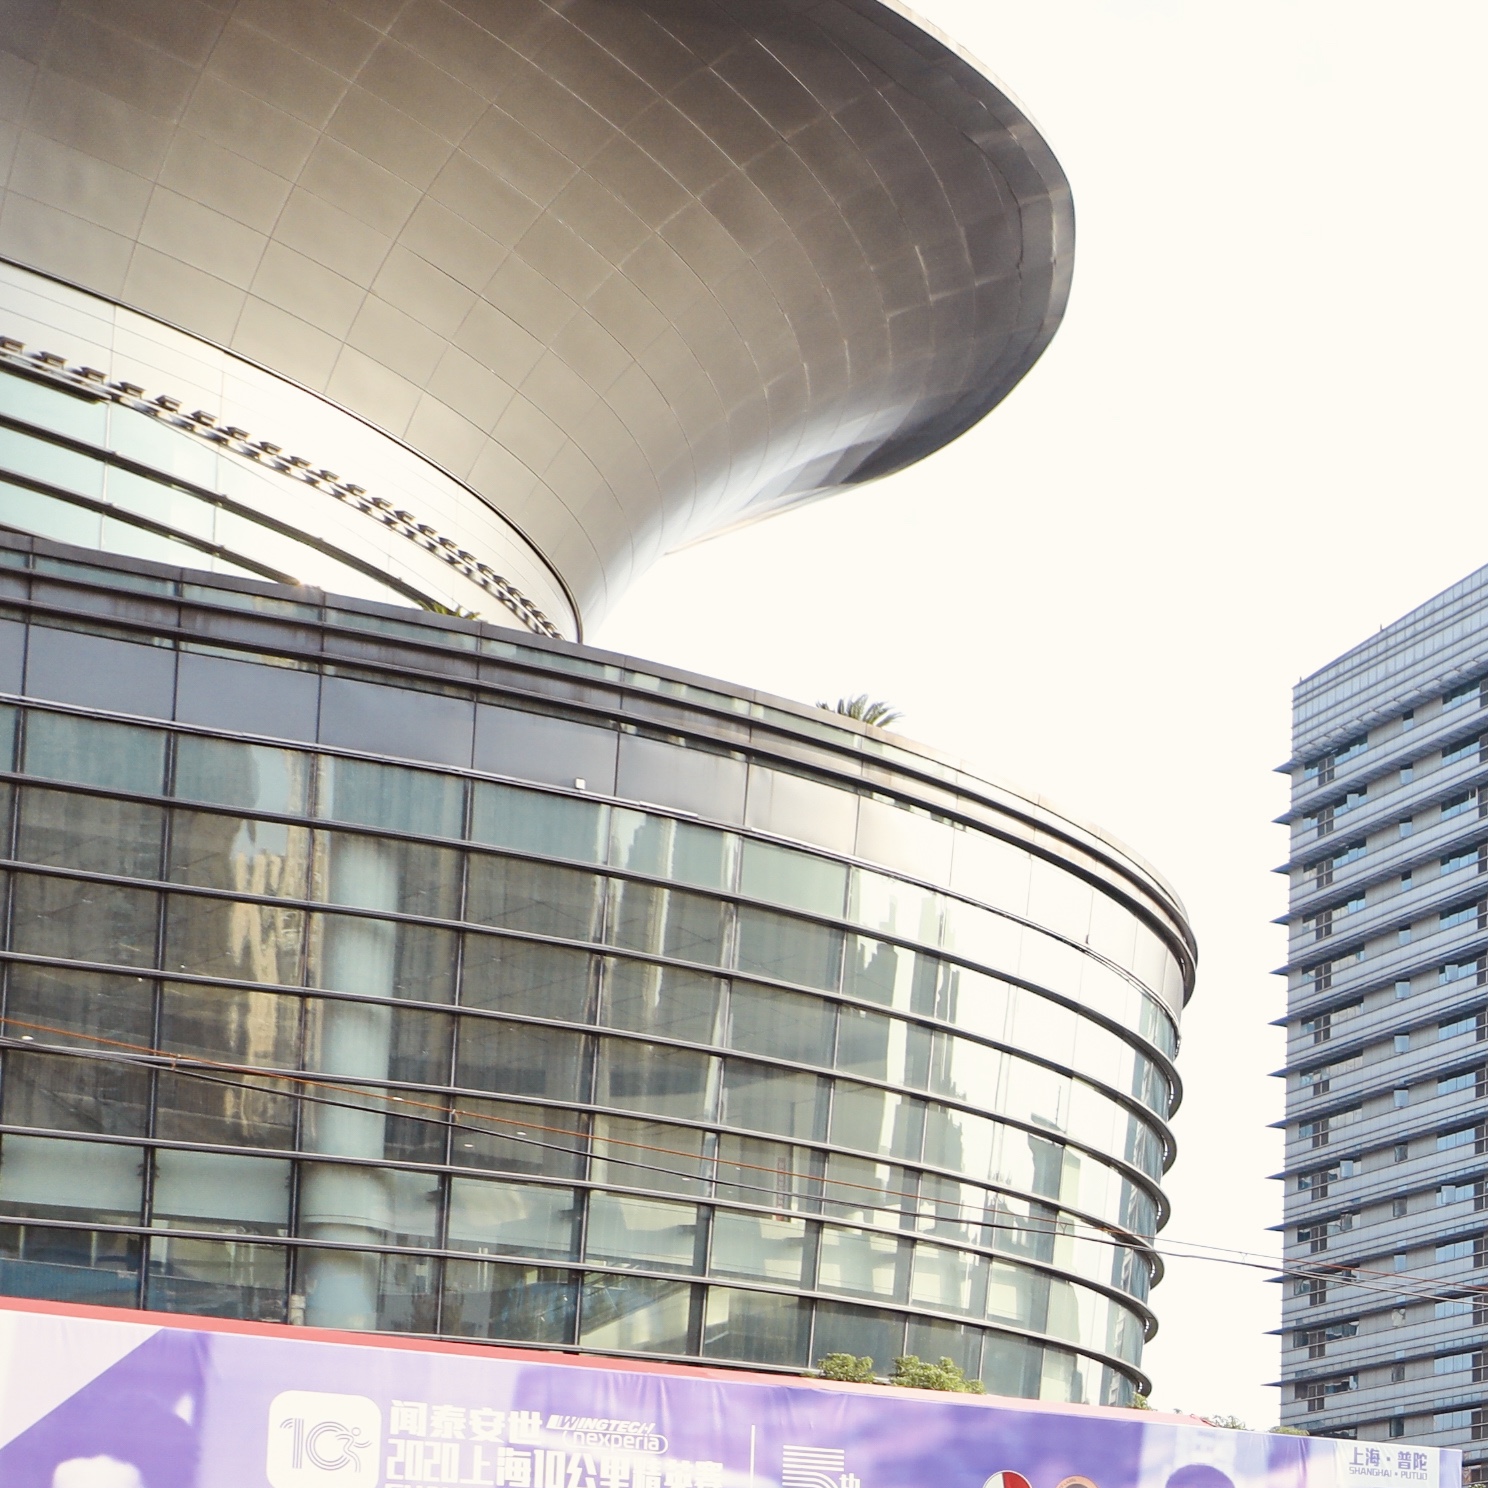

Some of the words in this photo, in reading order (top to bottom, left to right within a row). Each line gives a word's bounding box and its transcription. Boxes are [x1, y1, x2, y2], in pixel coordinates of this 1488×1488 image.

[390, 1400, 542, 1445] 闻泰安世
[546, 1414, 655, 1434] WINGTECH
[572, 1431, 660, 1453] nexperia
[1349, 1467, 1392, 1478] SHANGHAI
